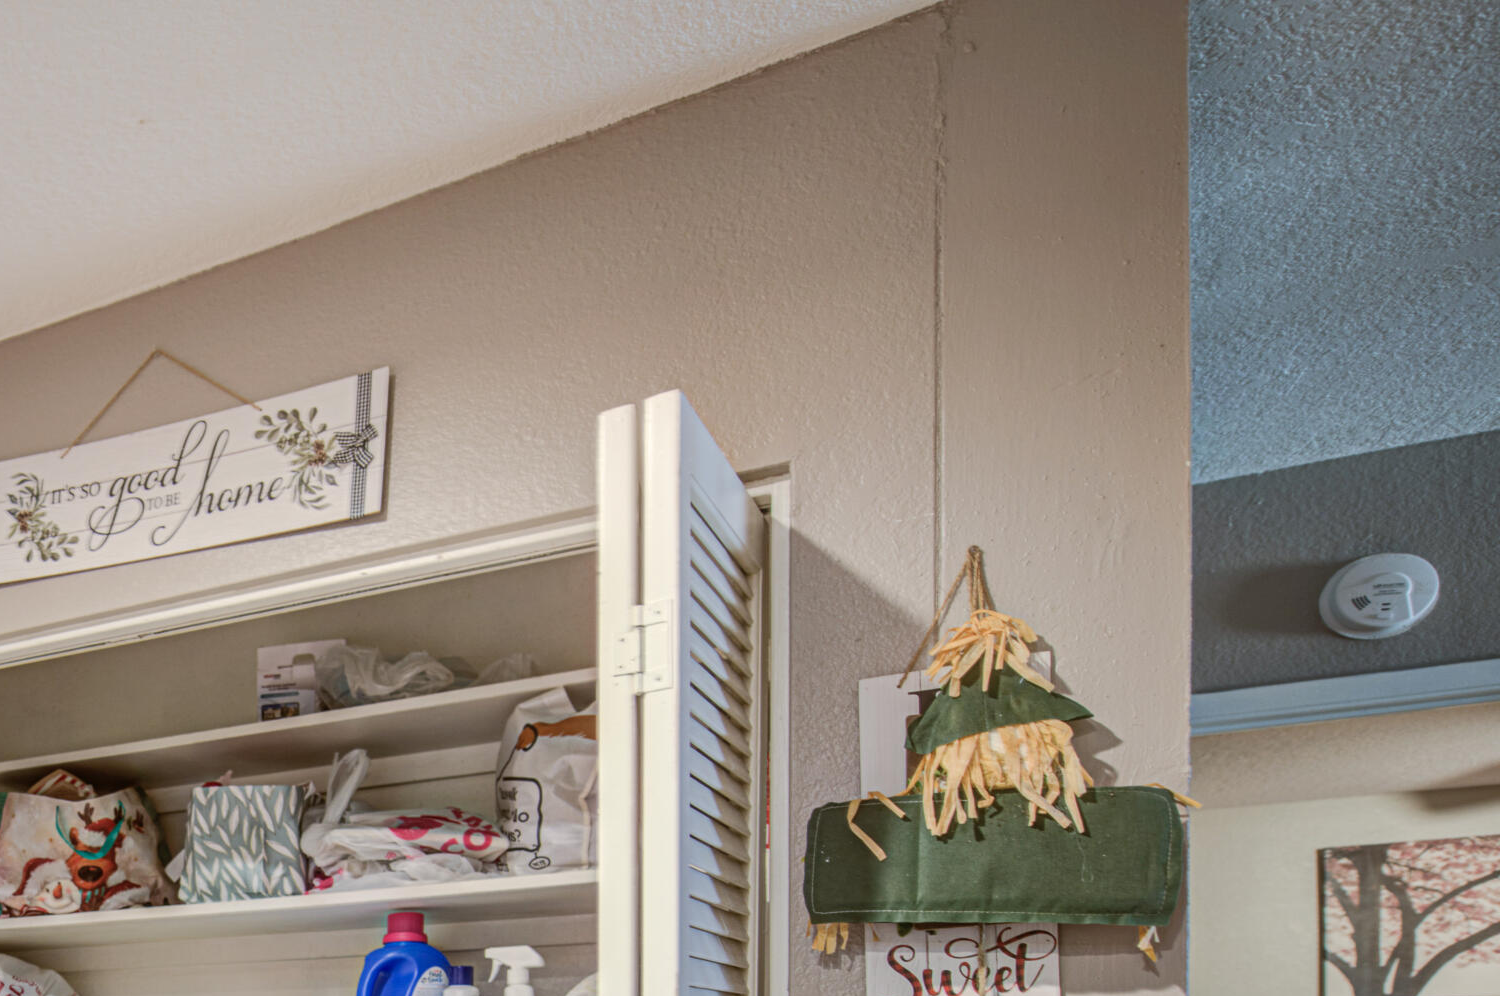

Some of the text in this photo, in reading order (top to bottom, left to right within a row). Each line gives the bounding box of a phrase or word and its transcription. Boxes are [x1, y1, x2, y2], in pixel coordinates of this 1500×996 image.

[79, 481, 101, 500] SO
[89, 420, 208, 551] good
[148, 429, 293, 546] TO BE home
